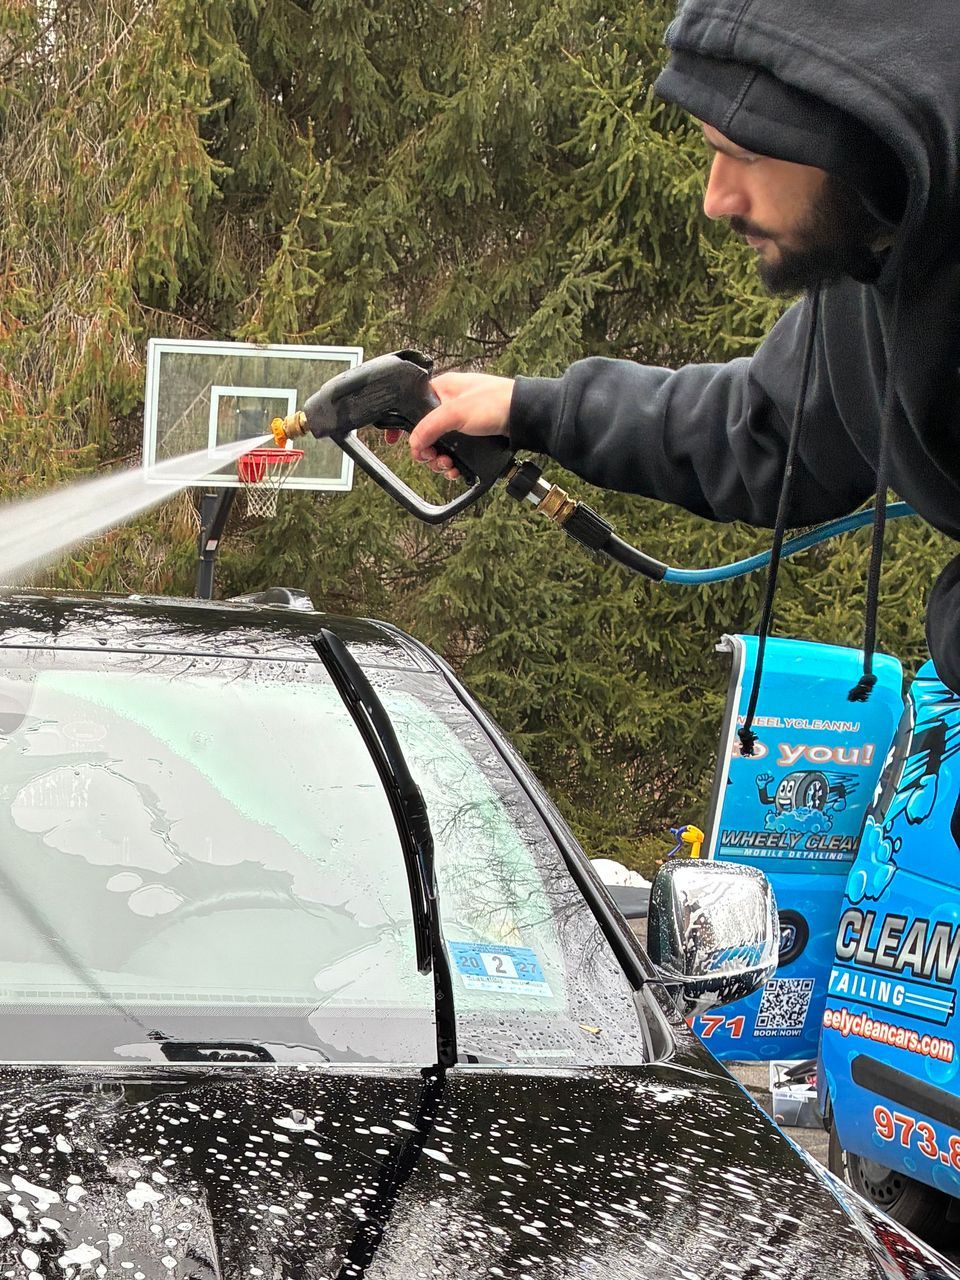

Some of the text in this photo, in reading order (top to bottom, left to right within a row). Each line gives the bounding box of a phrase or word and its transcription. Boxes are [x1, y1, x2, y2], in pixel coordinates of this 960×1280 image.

[777, 743, 875, 767] you!
[721, 830, 803, 848] WHEELY
[743, 848, 843, 860] MOBILE DETAILING
[836, 908, 960, 984] CLEAN
[460, 956, 479, 969] 20
[492, 956, 507, 974] 2
[823, 1008, 954, 1063] eelycleancars.com
